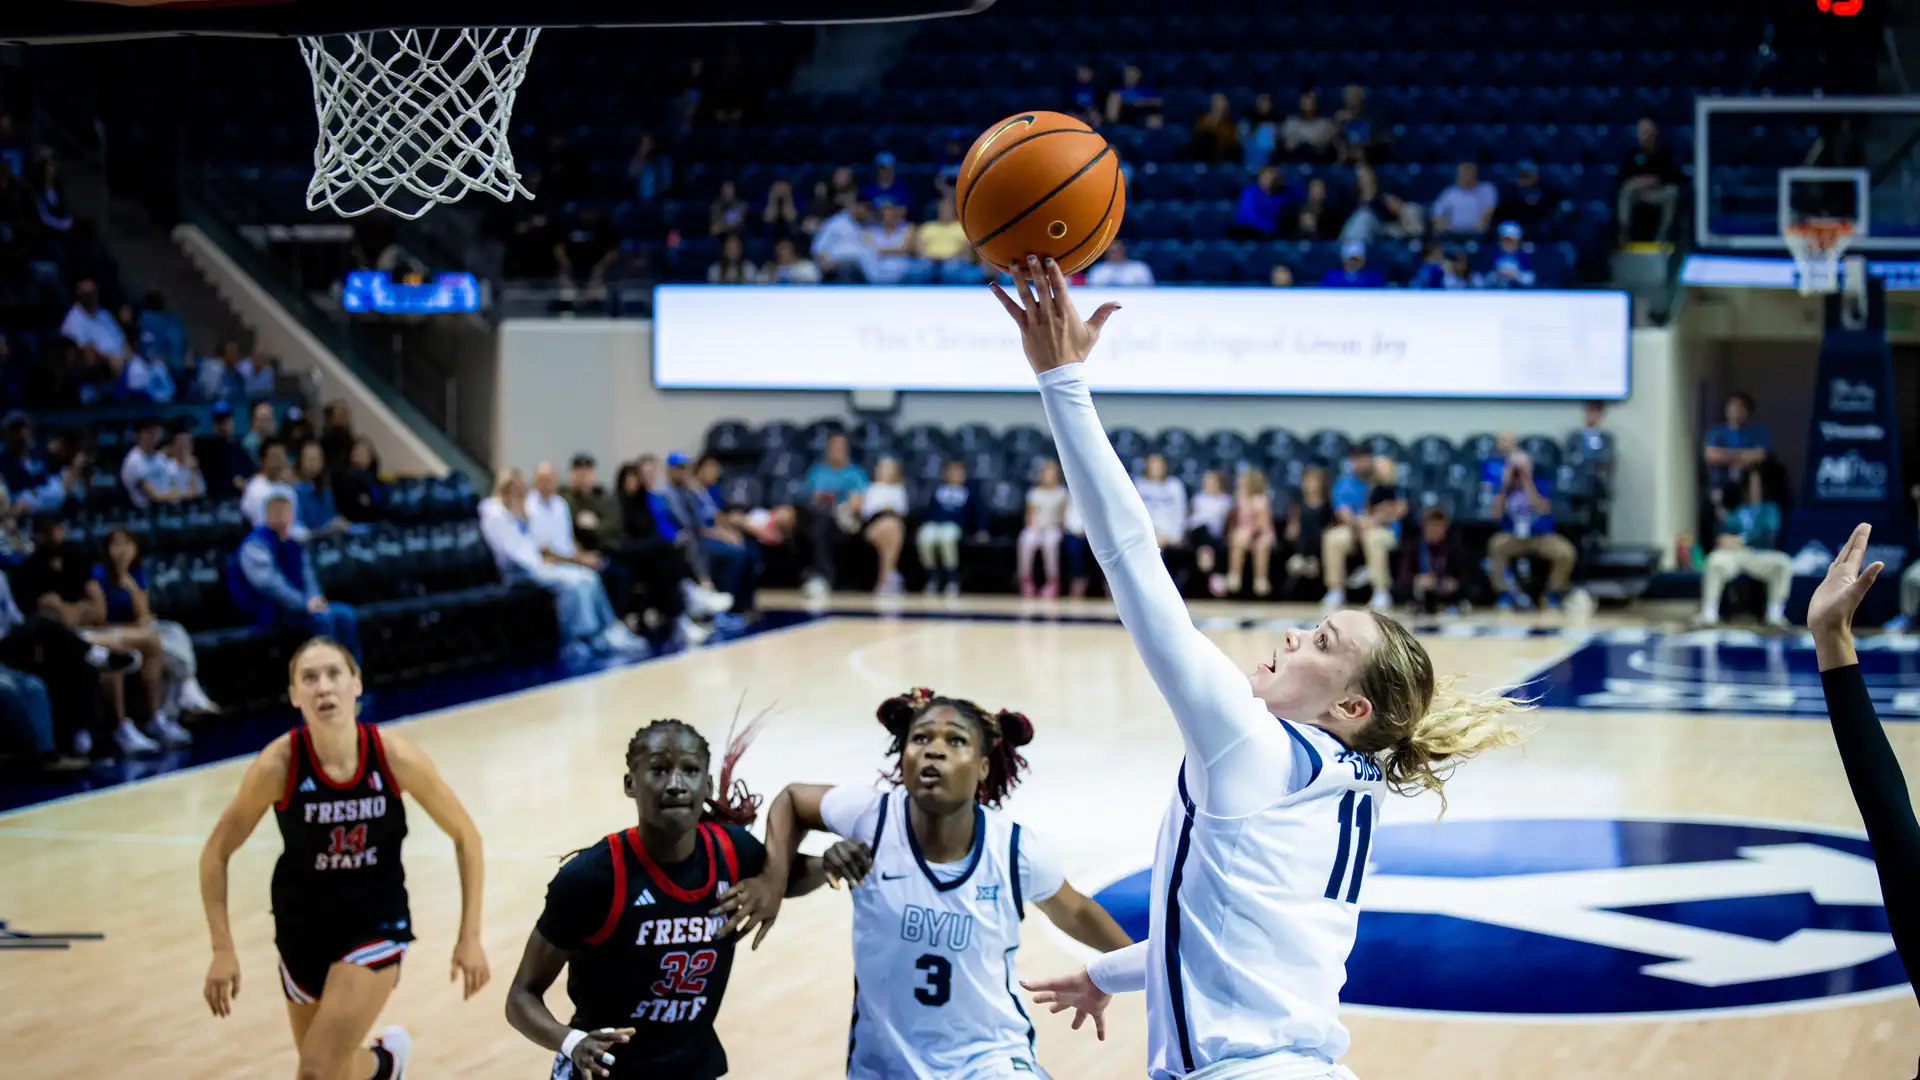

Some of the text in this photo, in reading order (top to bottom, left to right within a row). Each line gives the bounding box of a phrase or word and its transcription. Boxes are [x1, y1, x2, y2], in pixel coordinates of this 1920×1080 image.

[304, 795, 387, 823] FRESNO
[314, 846, 378, 870] STATE
[328, 823, 368, 854] 14
[1324, 789, 1373, 904] 11
[635, 915, 729, 946] FRESN
[901, 904, 973, 952] BYU
[650, 948, 717, 996] 32
[914, 953, 953, 1007] 3
